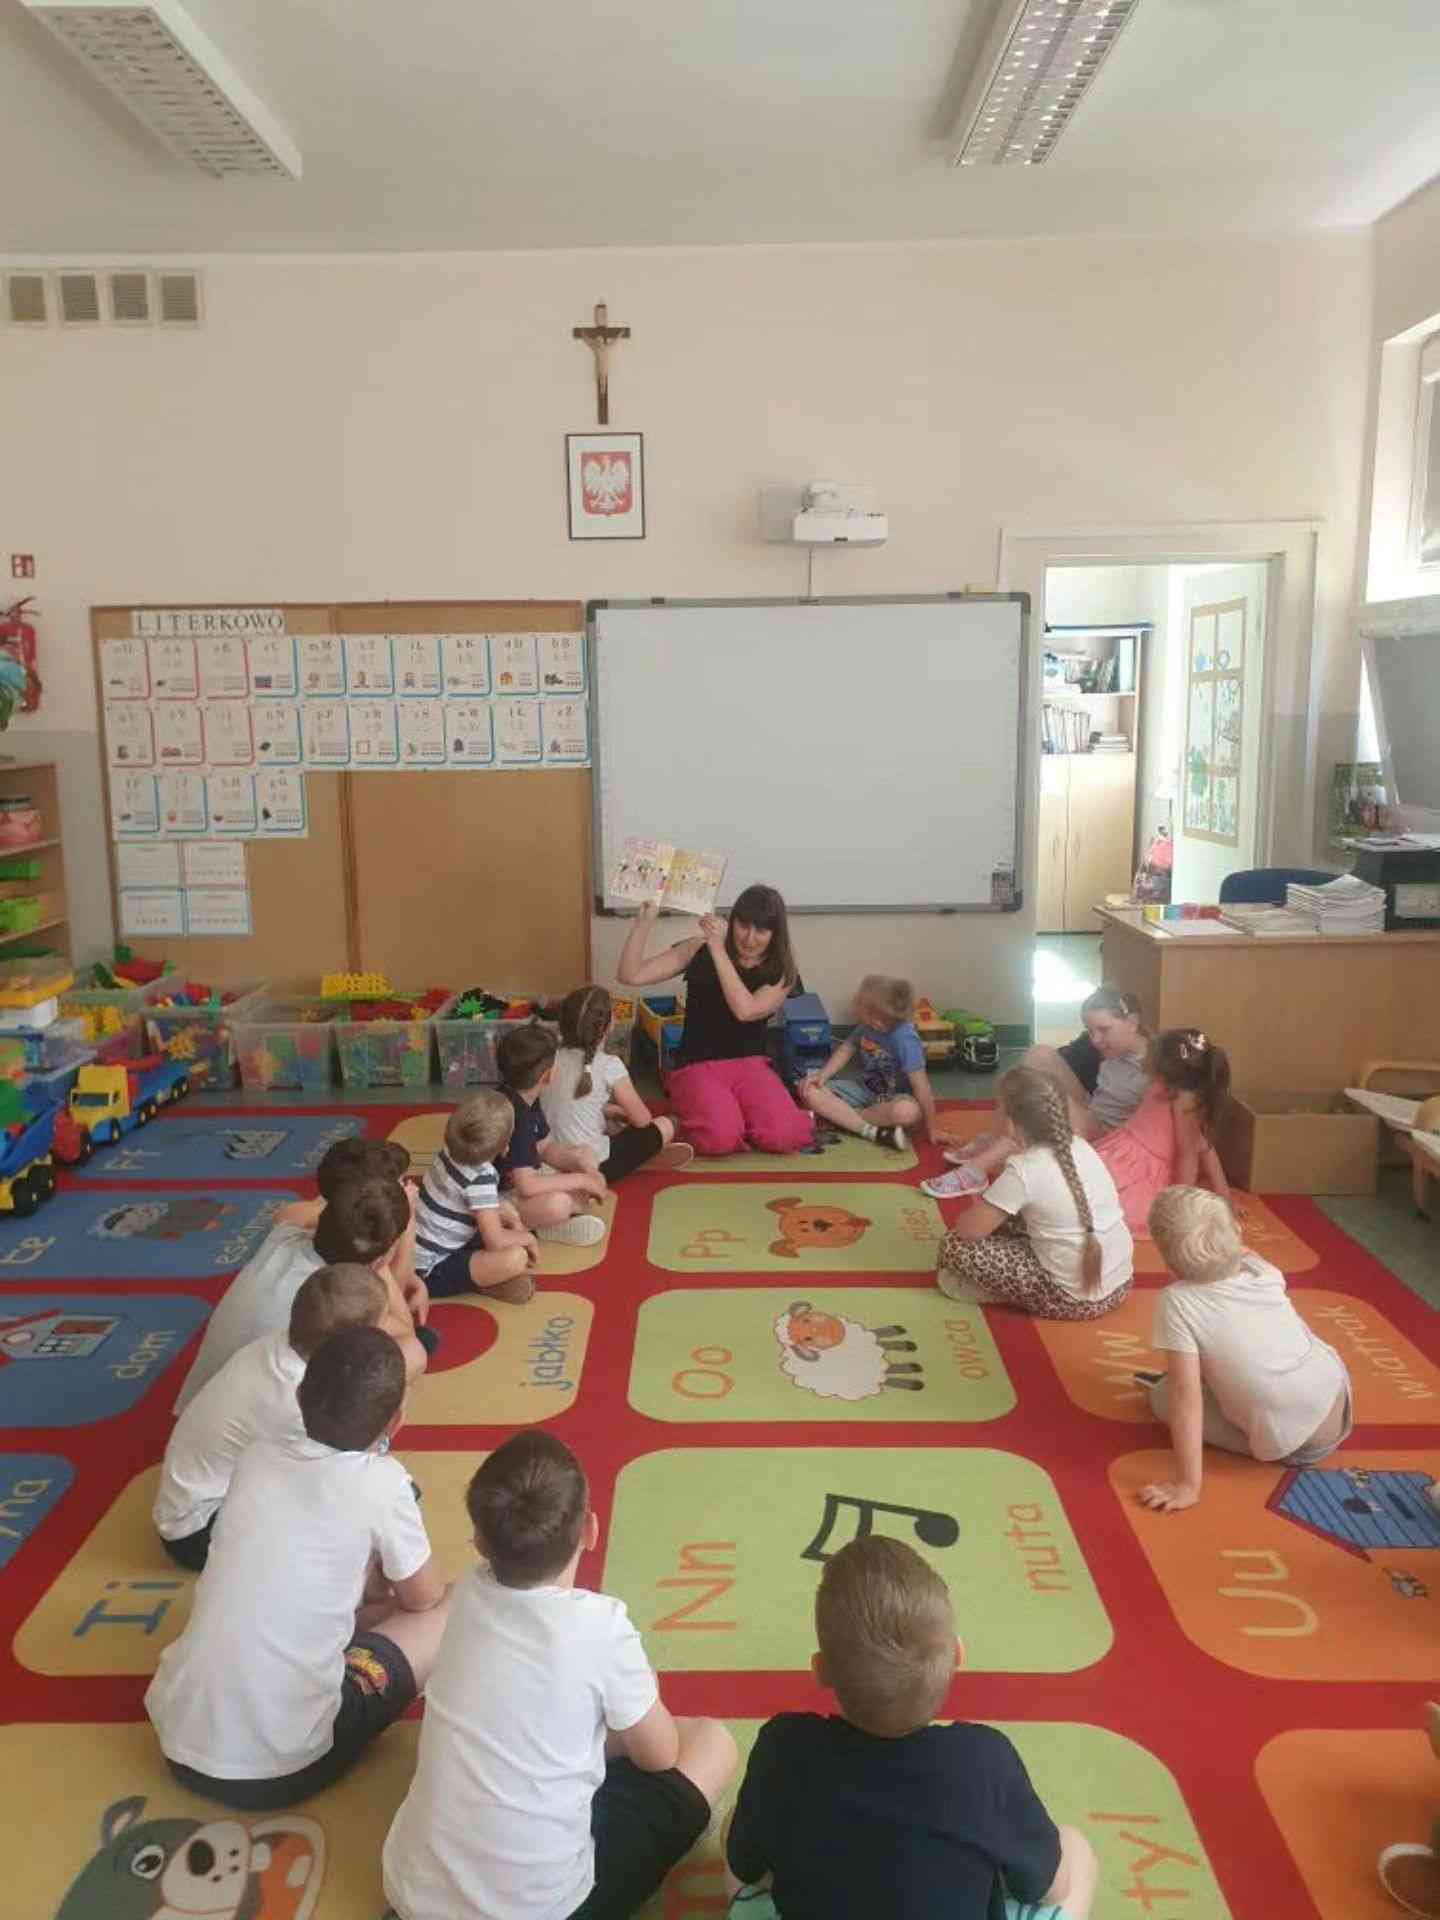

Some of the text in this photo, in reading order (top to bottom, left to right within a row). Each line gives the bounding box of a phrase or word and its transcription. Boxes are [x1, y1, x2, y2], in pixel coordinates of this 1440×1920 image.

[137, 613, 283, 632] LITERKOWO
[680, 1228, 746, 1260] Pp
[107, 1330, 177, 1379] dom
[519, 1317, 573, 1391] jabłko
[671, 1346, 733, 1401] Oo
[944, 1318, 988, 1381] owca
[1312, 1305, 1434, 1401] wiatrak
[1002, 1502, 1072, 1594] nuta
[73, 1582, 182, 1637] Ii
[651, 1541, 737, 1633] Nn
[1217, 1549, 1319, 1637] Uu
